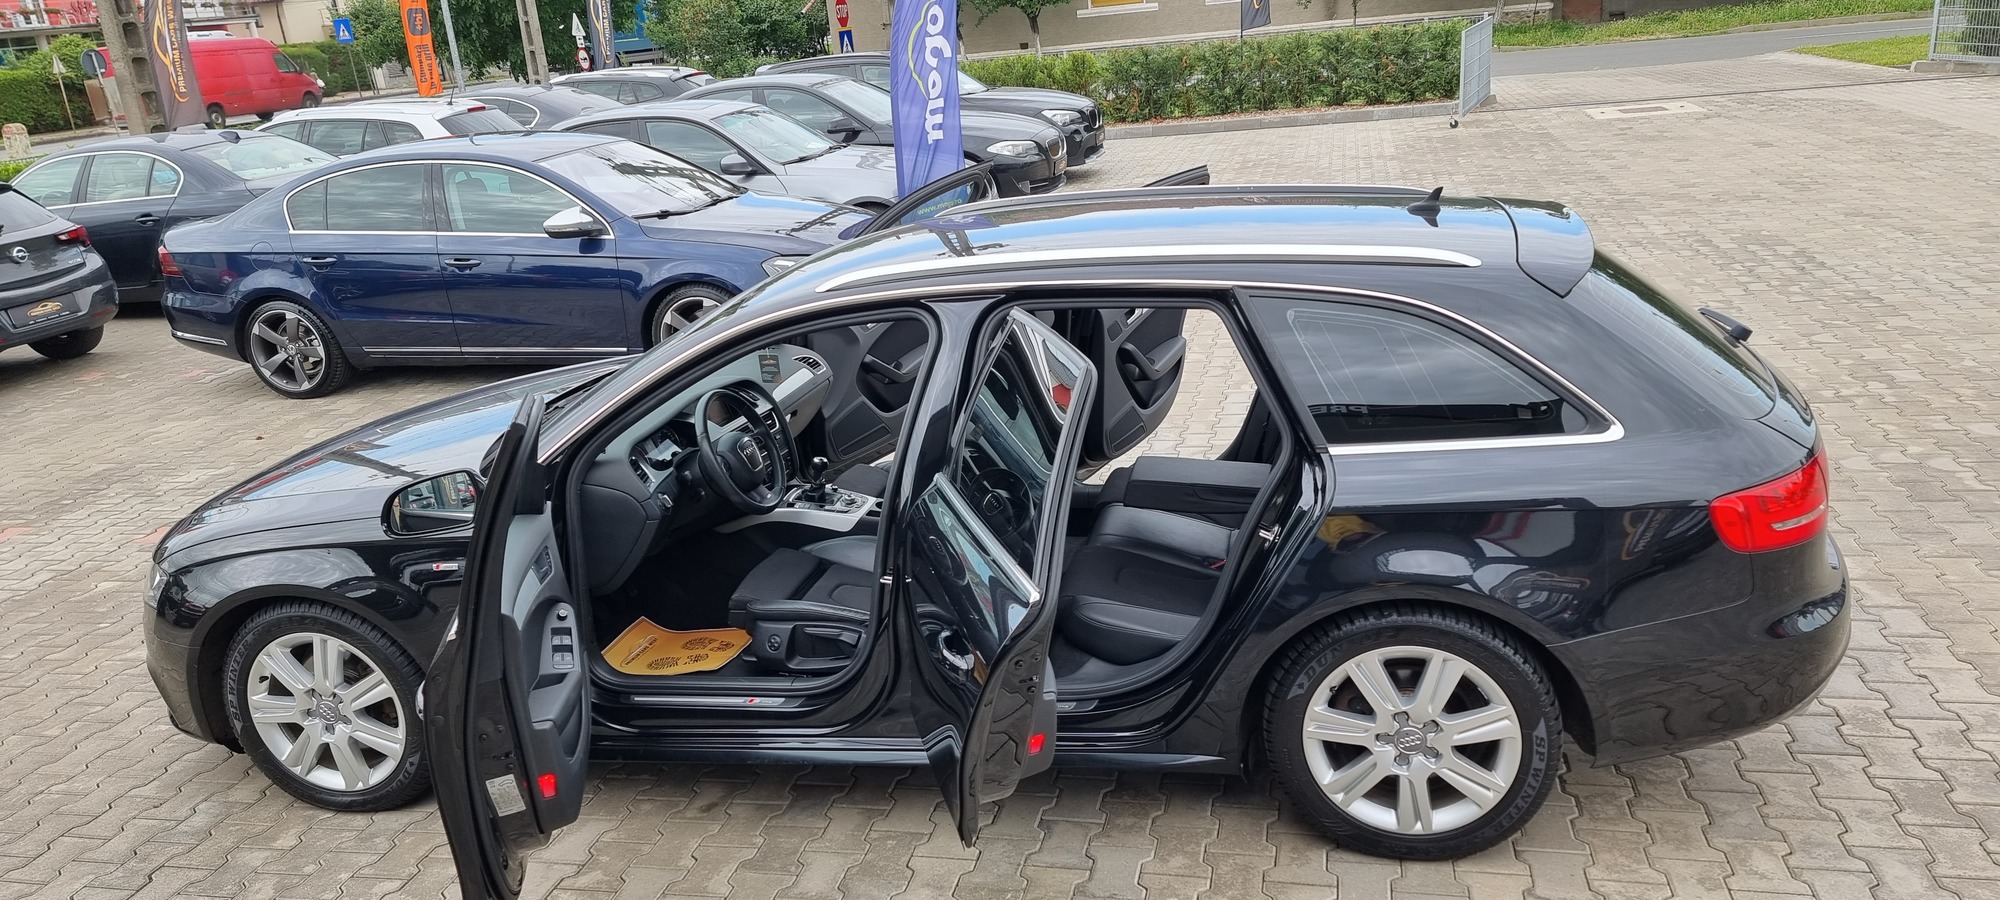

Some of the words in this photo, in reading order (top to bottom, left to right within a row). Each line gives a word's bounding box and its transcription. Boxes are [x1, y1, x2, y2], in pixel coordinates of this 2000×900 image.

[836, 4, 848, 18] STOP
[173, 48, 187, 93] PREMIUM
[1534, 735, 1545, 762] SP
[1491, 767, 1543, 833] WINTER
